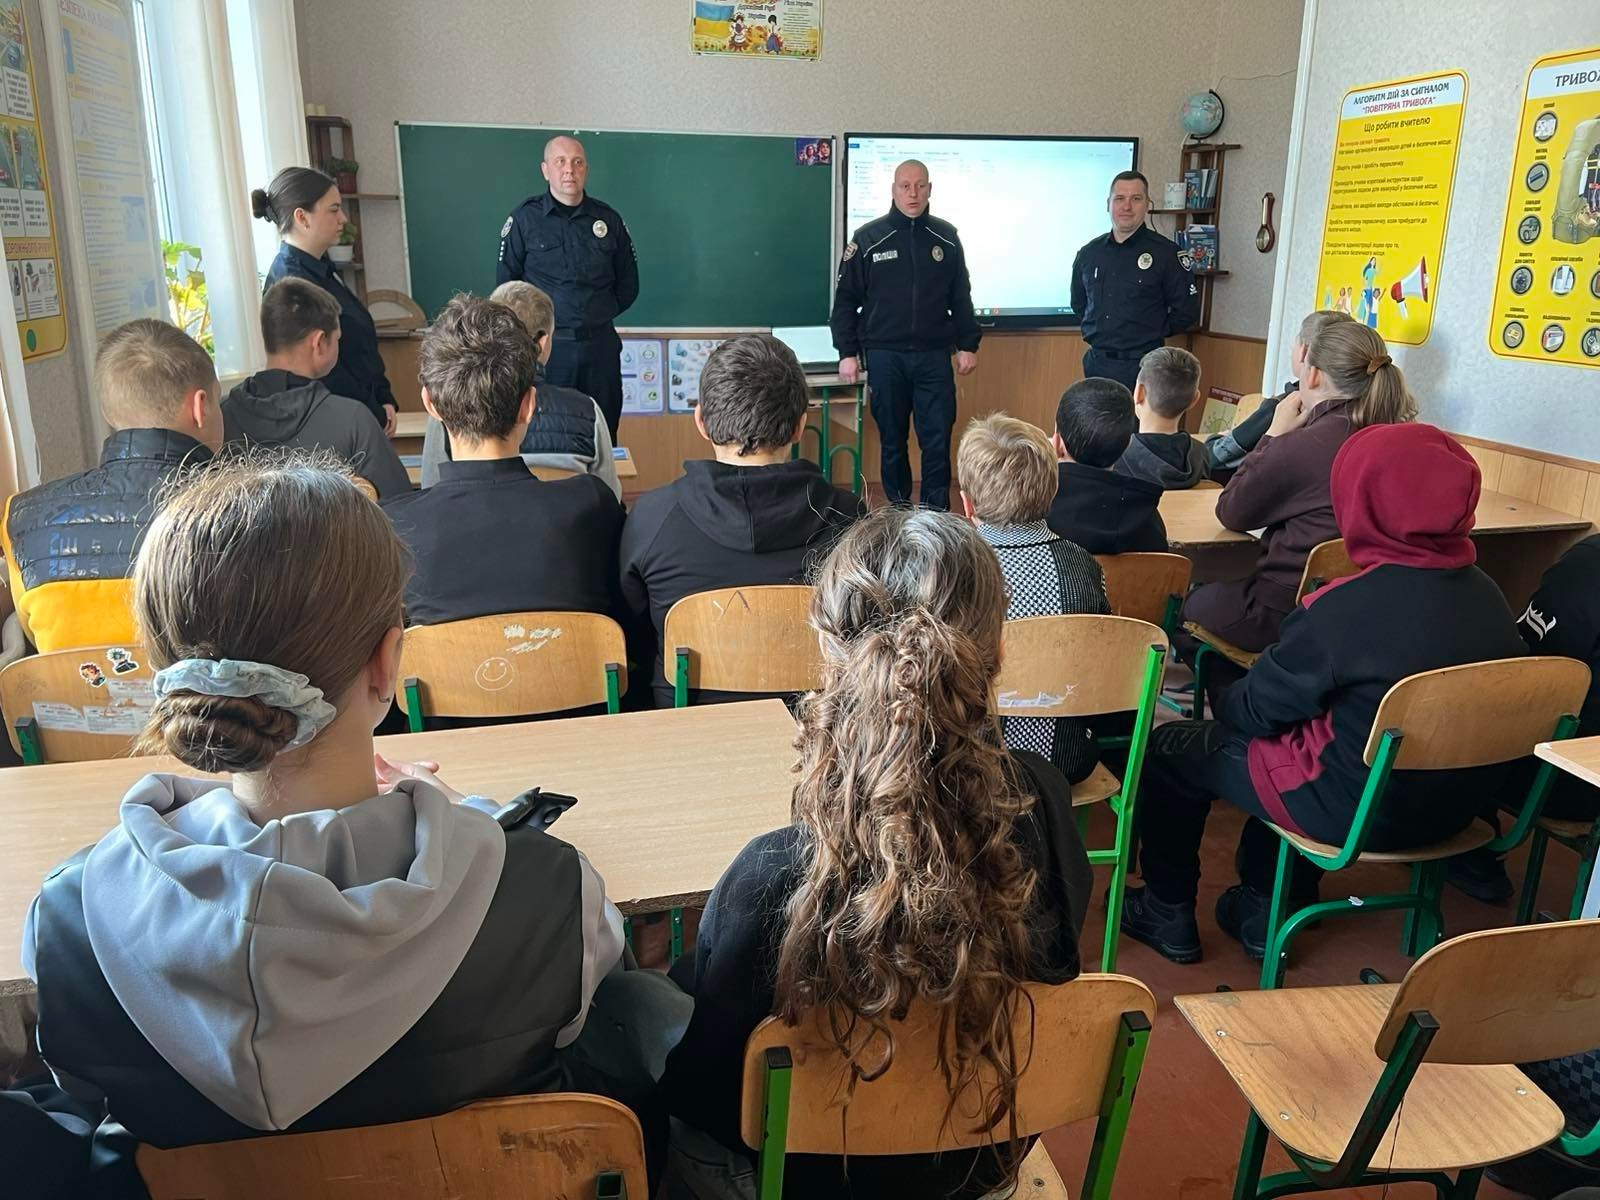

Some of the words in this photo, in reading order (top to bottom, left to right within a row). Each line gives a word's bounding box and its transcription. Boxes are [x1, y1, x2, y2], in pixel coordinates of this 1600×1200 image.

[1555, 69, 1600, 87] ТРИВО
[1354, 93, 1386, 105] АЛГОРИТМ
[1386, 88, 1400, 100] ДІЙ
[1400, 89, 1410, 98] ЗА
[1410, 82, 1449, 96] СИГНАЛОМ
[1364, 123, 1375, 132] Що
[1375, 120, 1399, 132] робити
[1400, 117, 1430, 128] вчителю
